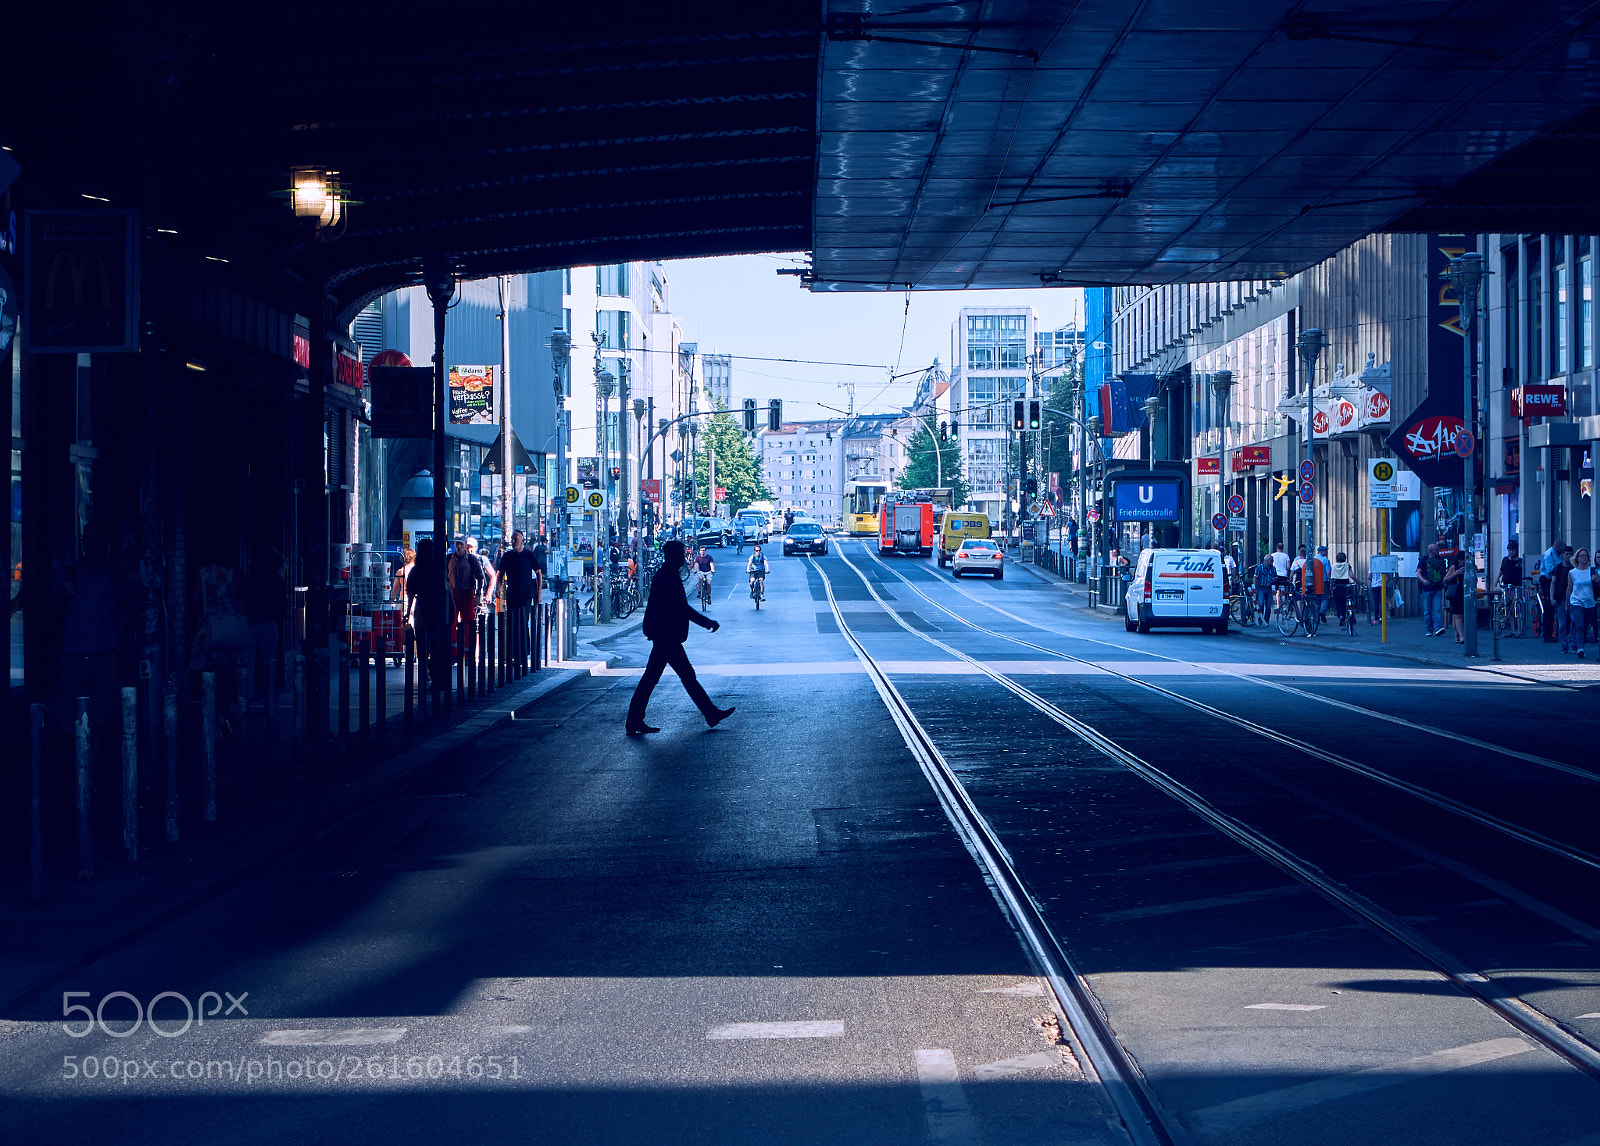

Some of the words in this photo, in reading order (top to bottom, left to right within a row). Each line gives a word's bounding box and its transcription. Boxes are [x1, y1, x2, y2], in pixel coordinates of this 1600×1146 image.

[1525, 394, 1559, 404] REWE
[1138, 485, 1153, 504] U
[1119, 508, 1173, 516] Friedrichstraße
[1208, 606, 1219, 615] 23
